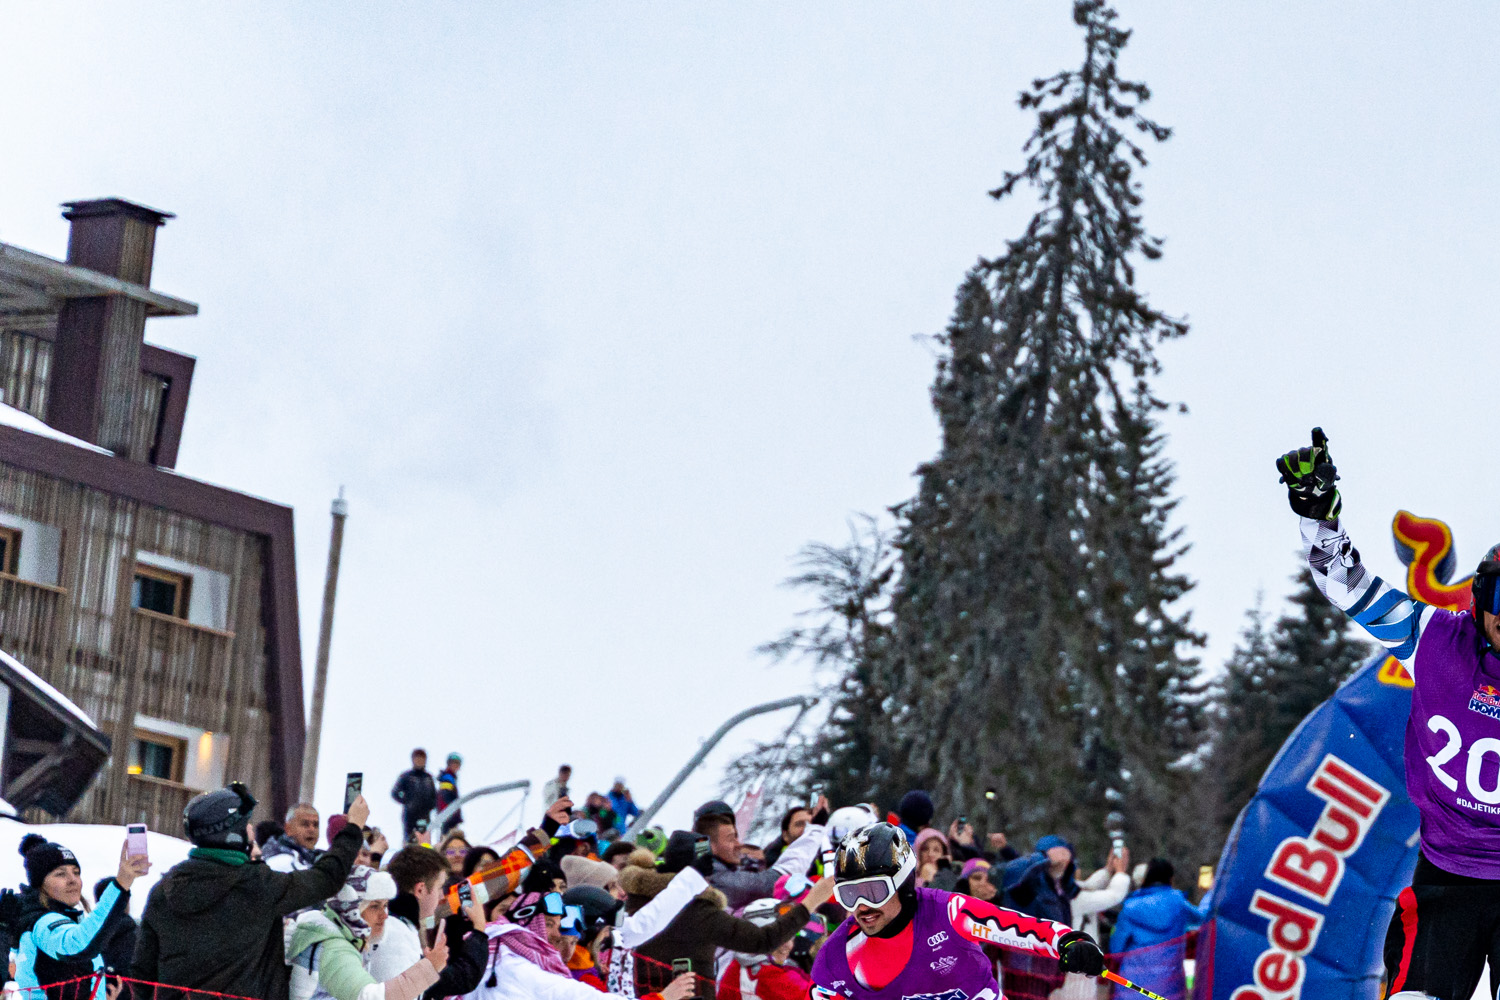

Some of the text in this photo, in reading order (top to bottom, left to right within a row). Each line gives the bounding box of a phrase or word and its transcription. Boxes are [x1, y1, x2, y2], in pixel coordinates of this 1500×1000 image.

[1264, 753, 1391, 905] Bull
[972, 923, 1033, 951] HT cronet
